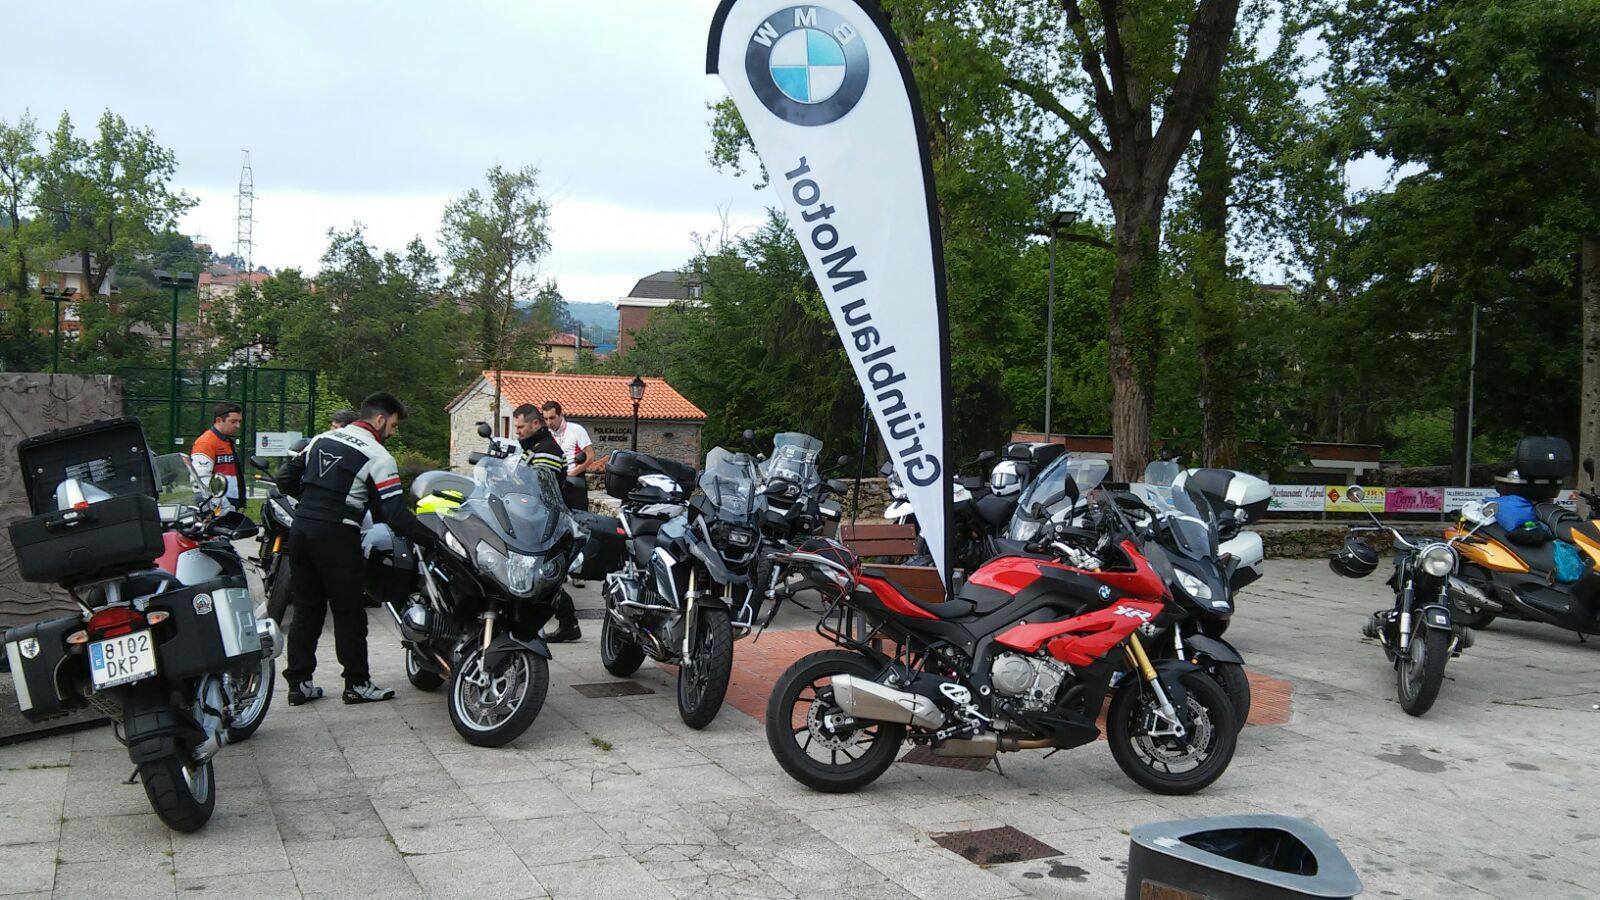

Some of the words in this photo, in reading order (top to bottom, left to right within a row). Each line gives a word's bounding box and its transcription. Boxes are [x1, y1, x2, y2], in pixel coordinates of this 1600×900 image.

[1113, 605, 1152, 621] XR
[105, 635, 148, 660] 8102
[107, 656, 138, 678] DKP
